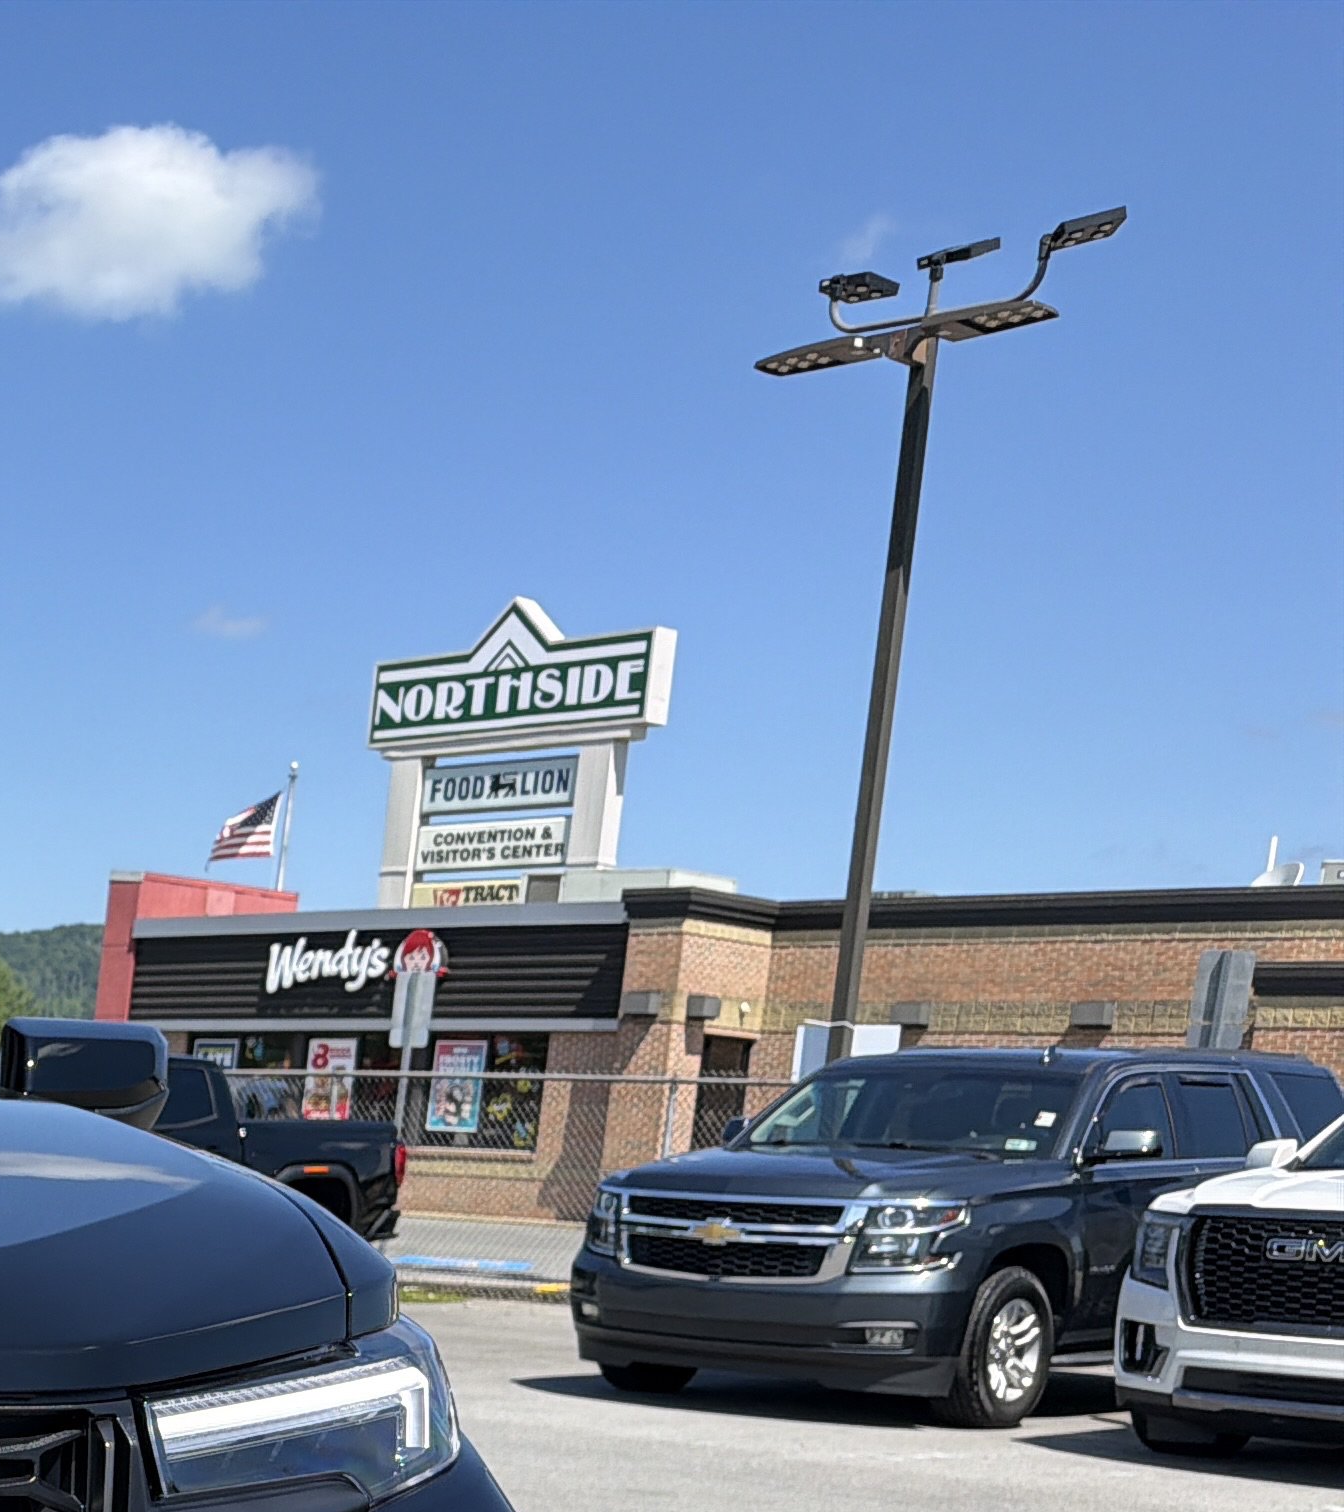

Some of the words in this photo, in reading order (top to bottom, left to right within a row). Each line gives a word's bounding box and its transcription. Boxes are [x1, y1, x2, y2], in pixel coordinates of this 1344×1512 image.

[374, 659, 645, 725] NORTHSIDE
[429, 775, 485, 803] FOOD
[520, 768, 571, 796] LION
[433, 827, 536, 847] CONVENTION
[541, 825, 553, 840] &
[420, 846, 496, 864] VISITOR'S
[500, 842, 566, 860] CENTER
[462, 883, 520, 903] TRACT
[266, 929, 390, 994] Wendy's
